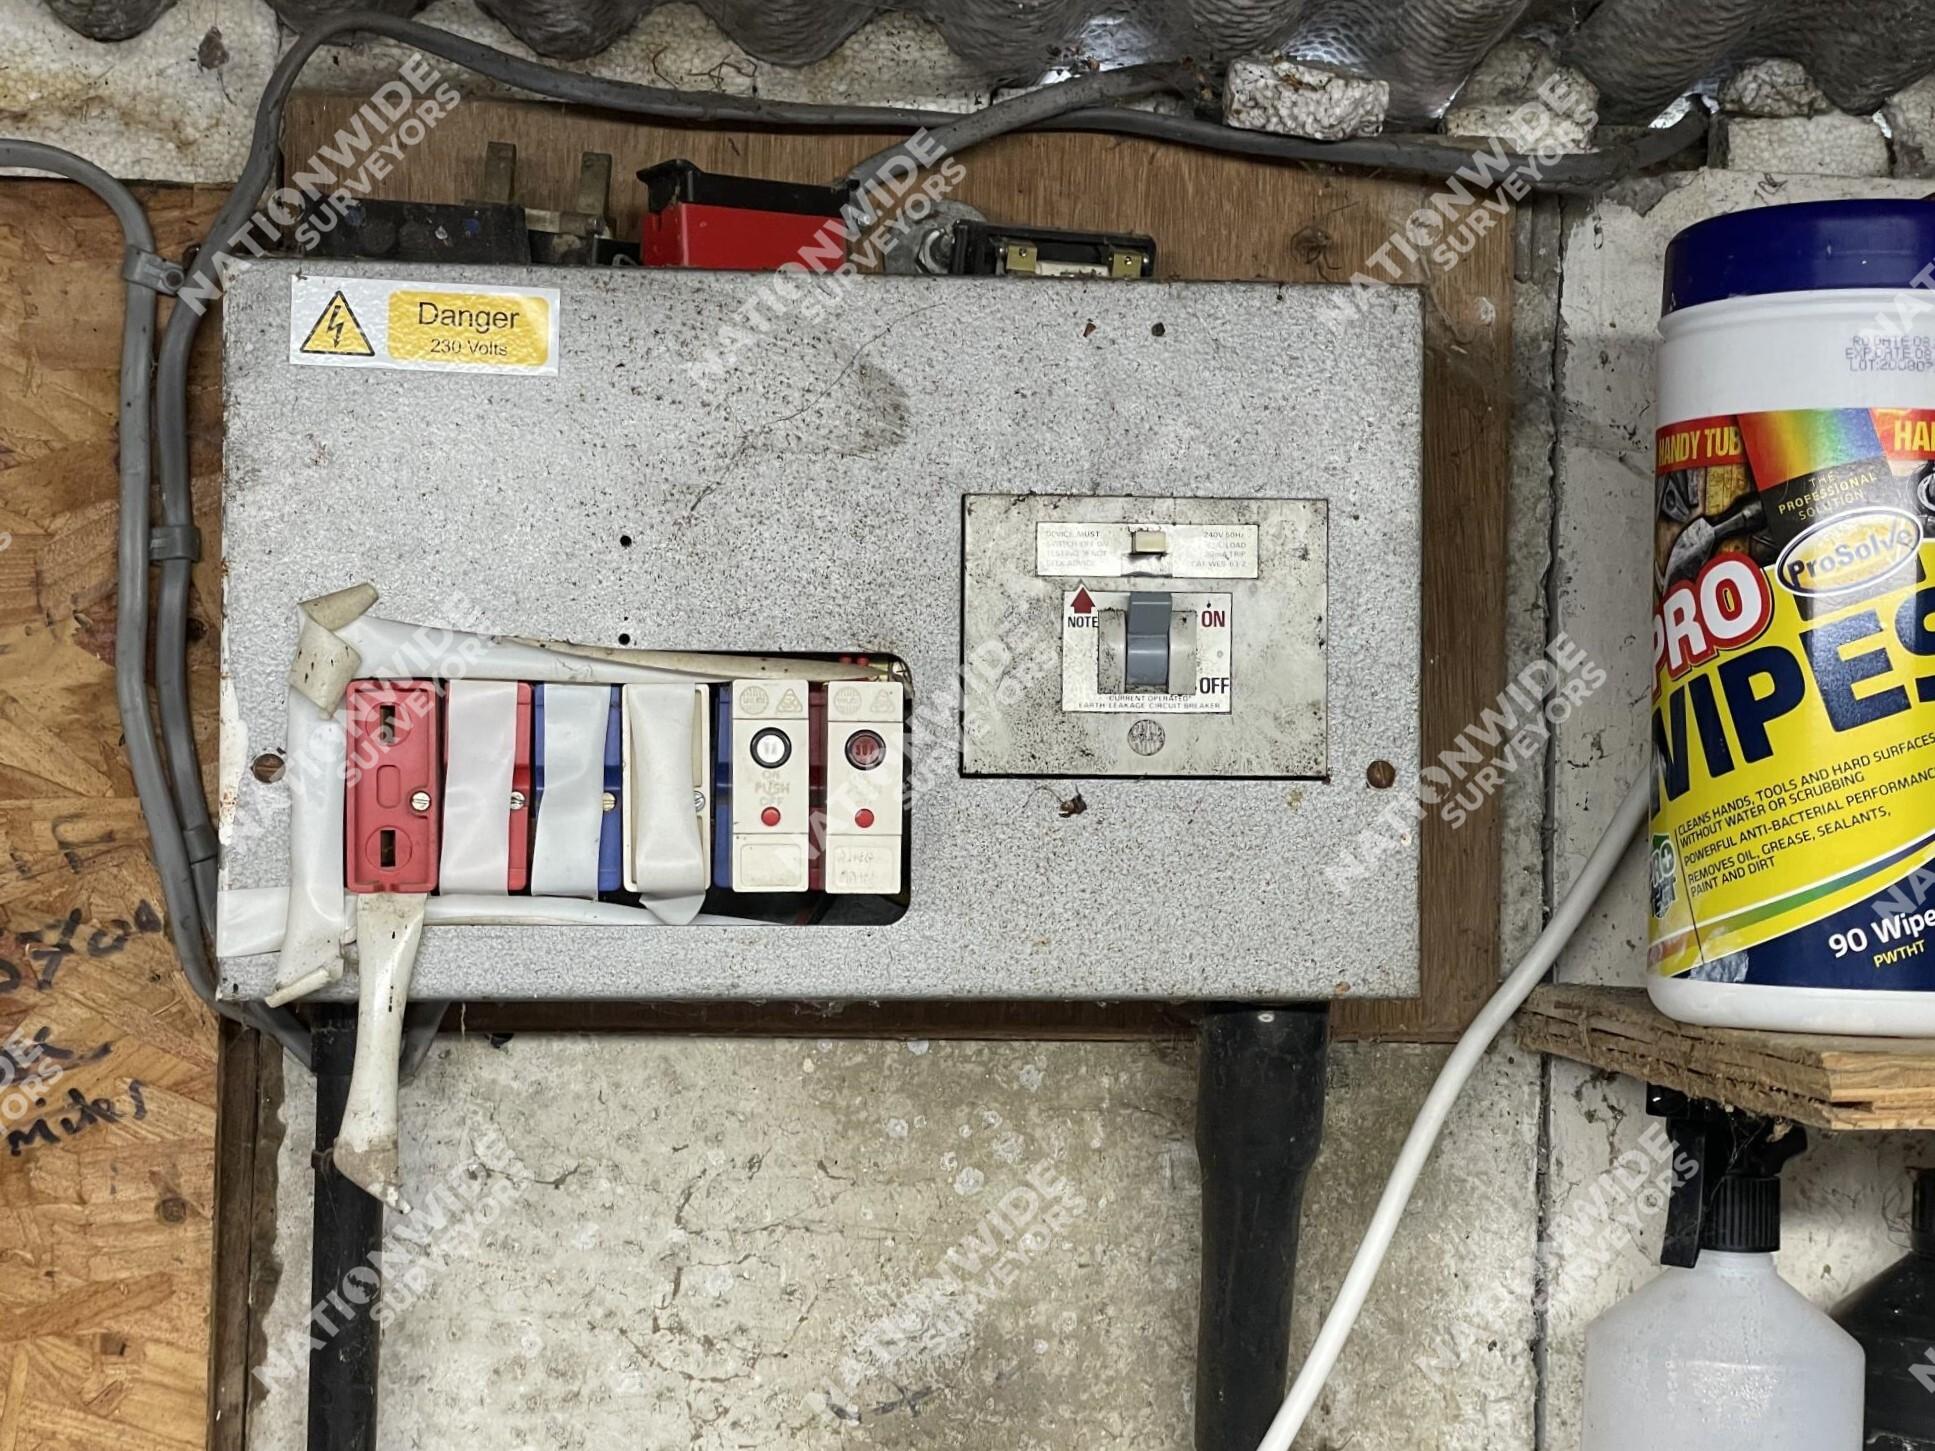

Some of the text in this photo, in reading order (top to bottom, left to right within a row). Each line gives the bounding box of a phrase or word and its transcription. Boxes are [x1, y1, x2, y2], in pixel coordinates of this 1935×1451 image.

[418, 301, 520, 334] Danger
[430, 338, 508, 357] 230 Volts
[1658, 426, 1742, 465] HANDY TUB
[1778, 472, 1877, 515] PROFESSIONAL
[1809, 471, 1836, 487] THE
[1798, 489, 1864, 520] SOLUTION
[1787, 518, 1915, 588] ProSolve
[1067, 616, 1098, 628] NOTE
[1201, 610, 1225, 627] ON
[1651, 555, 1768, 698] PRO
[1200, 677, 1229, 694] OFF
[1678, 811, 1711, 837] CLEANS
[1712, 796, 1755, 818] HANDS,
[1756, 779, 1797, 802] TOOLS
[1801, 769, 1829, 787] AND
[1832, 755, 1871, 776] HARD
[1680, 771, 1865, 848] WITHOUT WATER OR SCRUBBING
[1684, 835, 1737, 866] POWERFUL
[1740, 800, 1843, 843] ANTI-BACTERIAL
[1688, 805, 1891, 884] REMOVES OIL, GREASE, SEALANTS,
[1691, 856, 1775, 897] PAINT AND DIRT
[1828, 928, 1868, 958] 90
[1873, 940, 1925, 968] PWTHT
